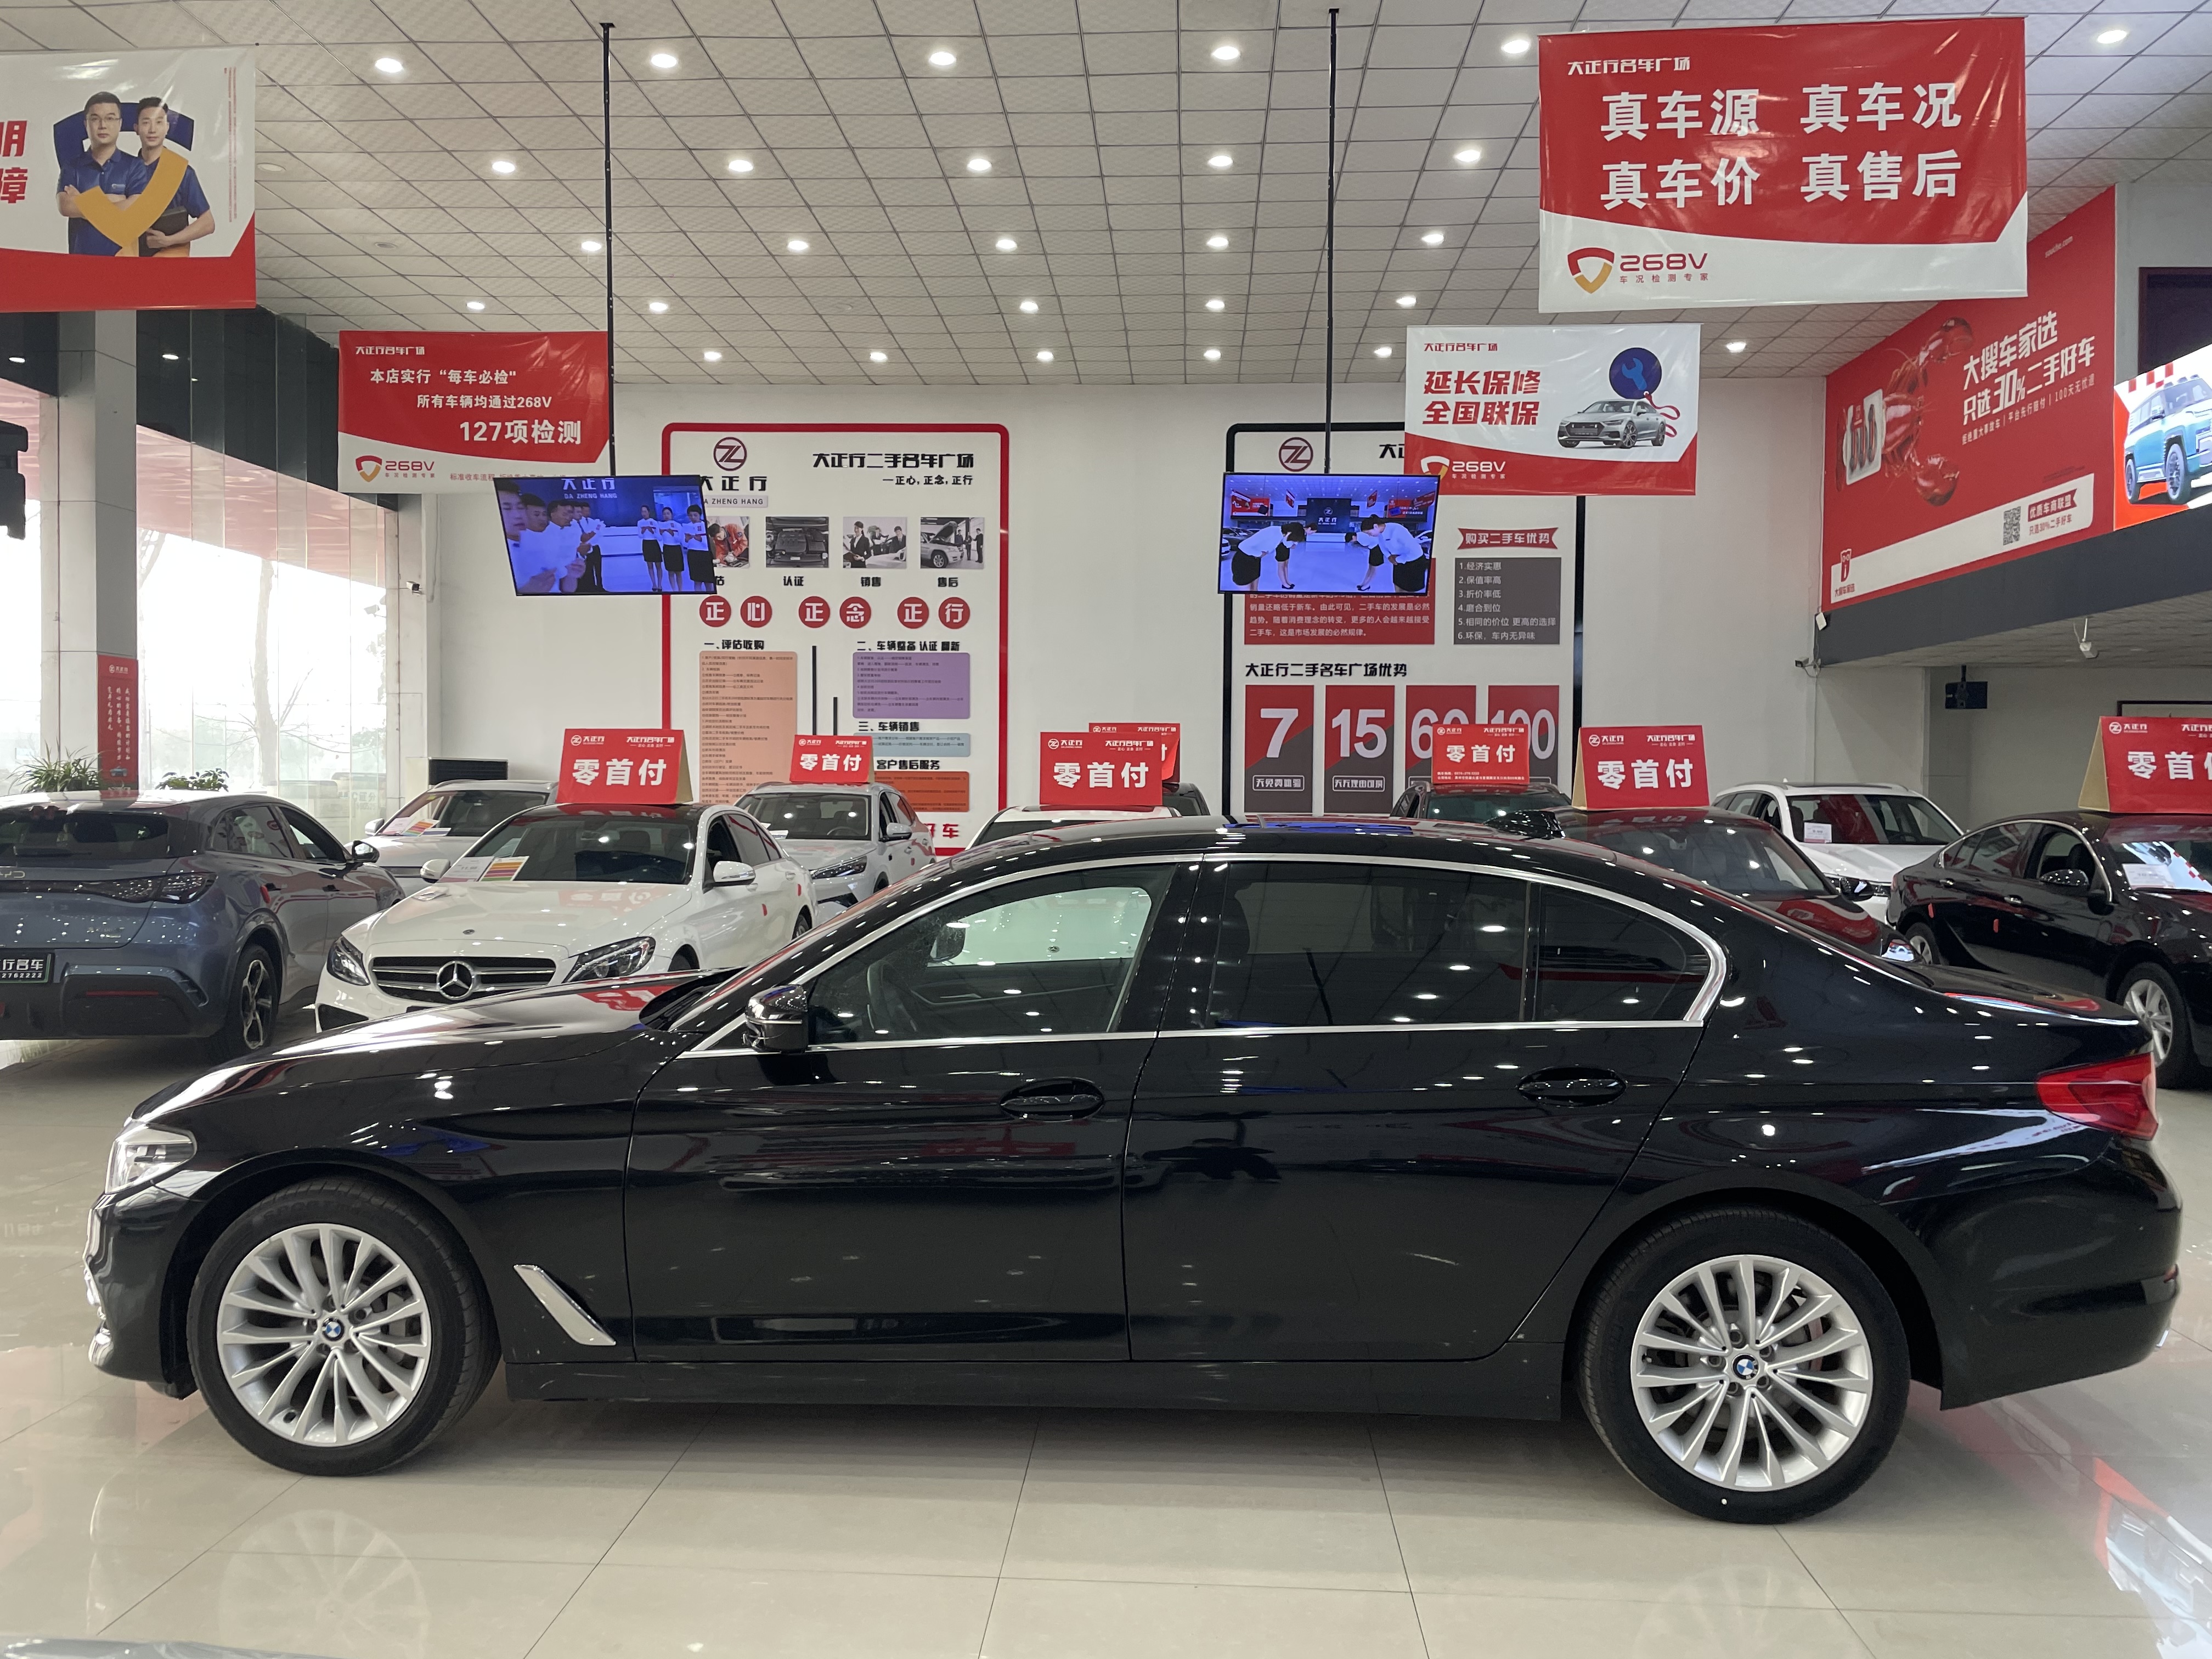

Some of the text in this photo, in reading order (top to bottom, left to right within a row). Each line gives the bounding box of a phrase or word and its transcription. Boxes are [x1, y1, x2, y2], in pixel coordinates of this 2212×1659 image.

[1567, 57, 1690, 76] 大正行名车广场
[1601, 82, 1962, 142] 真车源 真车况
[1600, 149, 1962, 211] 真车价 真售后
[1620, 252, 1708, 272] 268V
[1620, 272, 1709, 285] 车况检测专家
[356, 346, 425, 355] 大正行名车广场
[1424, 343, 1498, 352] 大正行名车广场
[1963, 311, 2057, 391] 大搜车家选
[1423, 370, 1541, 395] 延长保修
[1963, 336, 2095, 426] 只选30%二手好车
[417, 394, 552, 409] 所有车辆均通过268V
[1423, 401, 1540, 425] 全国联保
[460, 419, 582, 444] 127项检测
[385, 461, 435, 471] 268V
[812, 453, 974, 469] 大正行二手名车广场
[1452, 461, 1506, 472] 268V
[1465, 532, 1550, 545] 购买二手车优势
[783, 576, 804, 586] 认证
[861, 577, 882, 587] 销售
[938, 577, 959, 588] 售后
[1245, 663, 1407, 678] 大正行二手名车广场优势
[1261, 708, 1299, 758] 7
[1331, 709, 1387, 759] 15
[800, 754, 862, 771] 零首付
[1446, 744, 1515, 763] 零首付
[572, 759, 667, 786] 零首付
[1053, 762, 1149, 788] 零首付
[1598, 758, 1693, 789] 零首付
[2128, 751, 2212, 780] 零首
